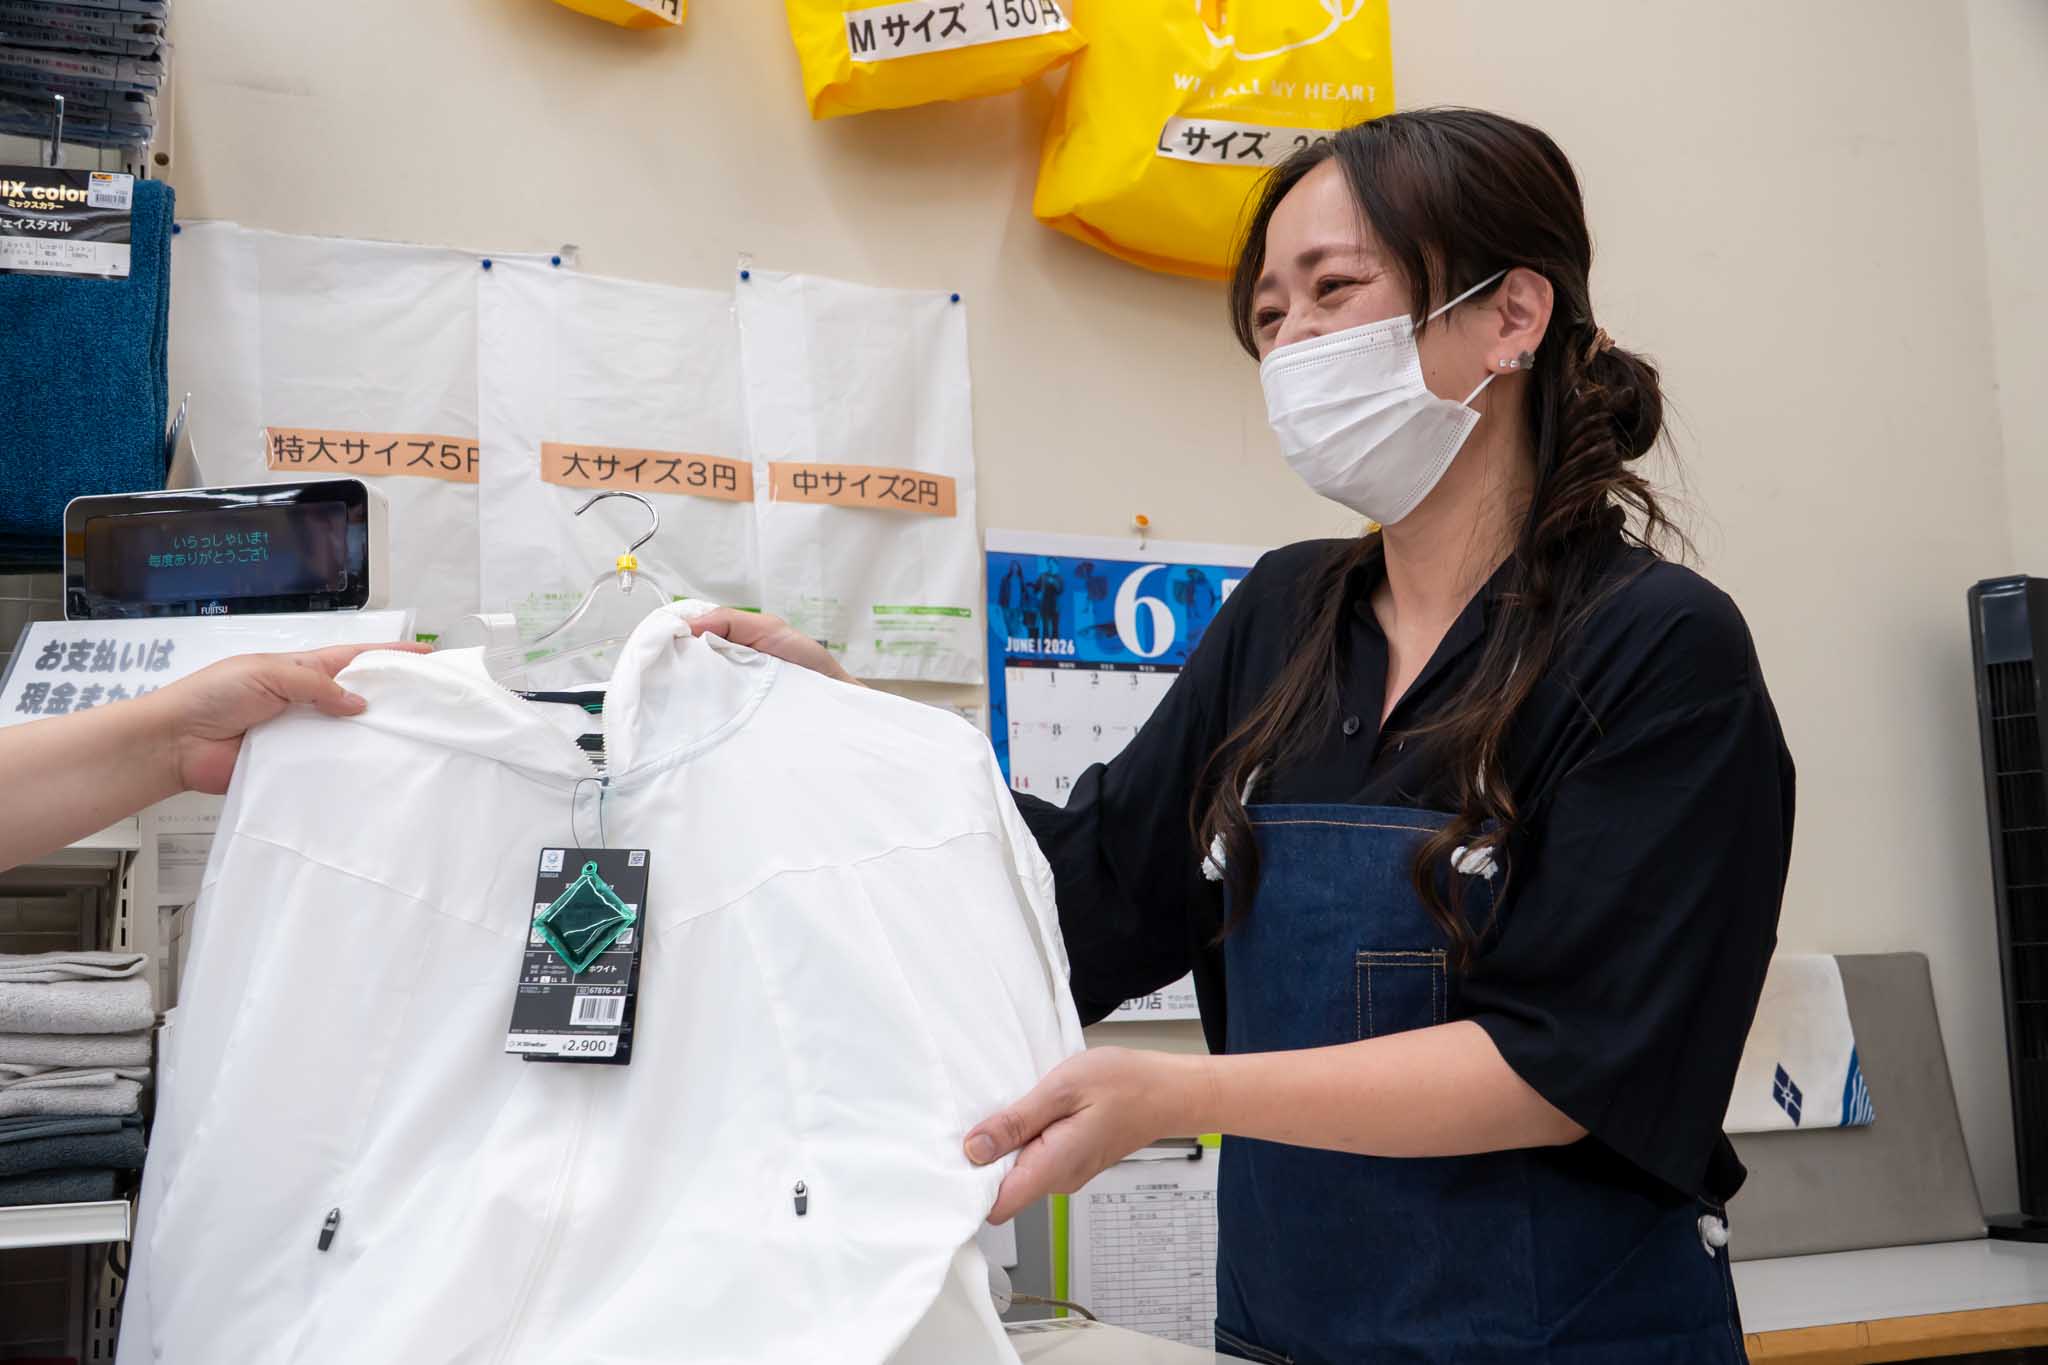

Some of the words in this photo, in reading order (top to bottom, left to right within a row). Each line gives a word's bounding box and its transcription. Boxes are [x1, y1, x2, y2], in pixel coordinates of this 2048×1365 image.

[849, 19, 877, 54] M
[881, 2, 967, 47] サイズ
[1303, 82, 1377, 103] HEART
[1181, 126, 1271, 160] サイズ
[0, 180, 26, 199] IX
[31, 185, 89, 203] color
[8, 199, 65, 210] ミックスカラー
[0, 217, 72, 232] ェイスタオル
[560, 451, 737, 492] 大サイズ3円
[792, 469, 940, 507] 中サイズ2円
[201, 601, 228, 615] FUJITSU
[1114, 563, 1176, 658] 6
[34, 637, 176, 673] お支払いは
[1005, 637, 1035, 653] JUNE
[1043, 638, 1076, 656] 2026
[1090, 673, 1099, 685] 2
[1129, 674, 1139, 686] 3
[1052, 723, 1062, 737] 8
[1093, 725, 1102, 738] 9
[1014, 775, 1029, 789] 14
[1055, 775, 1071, 790] 15
